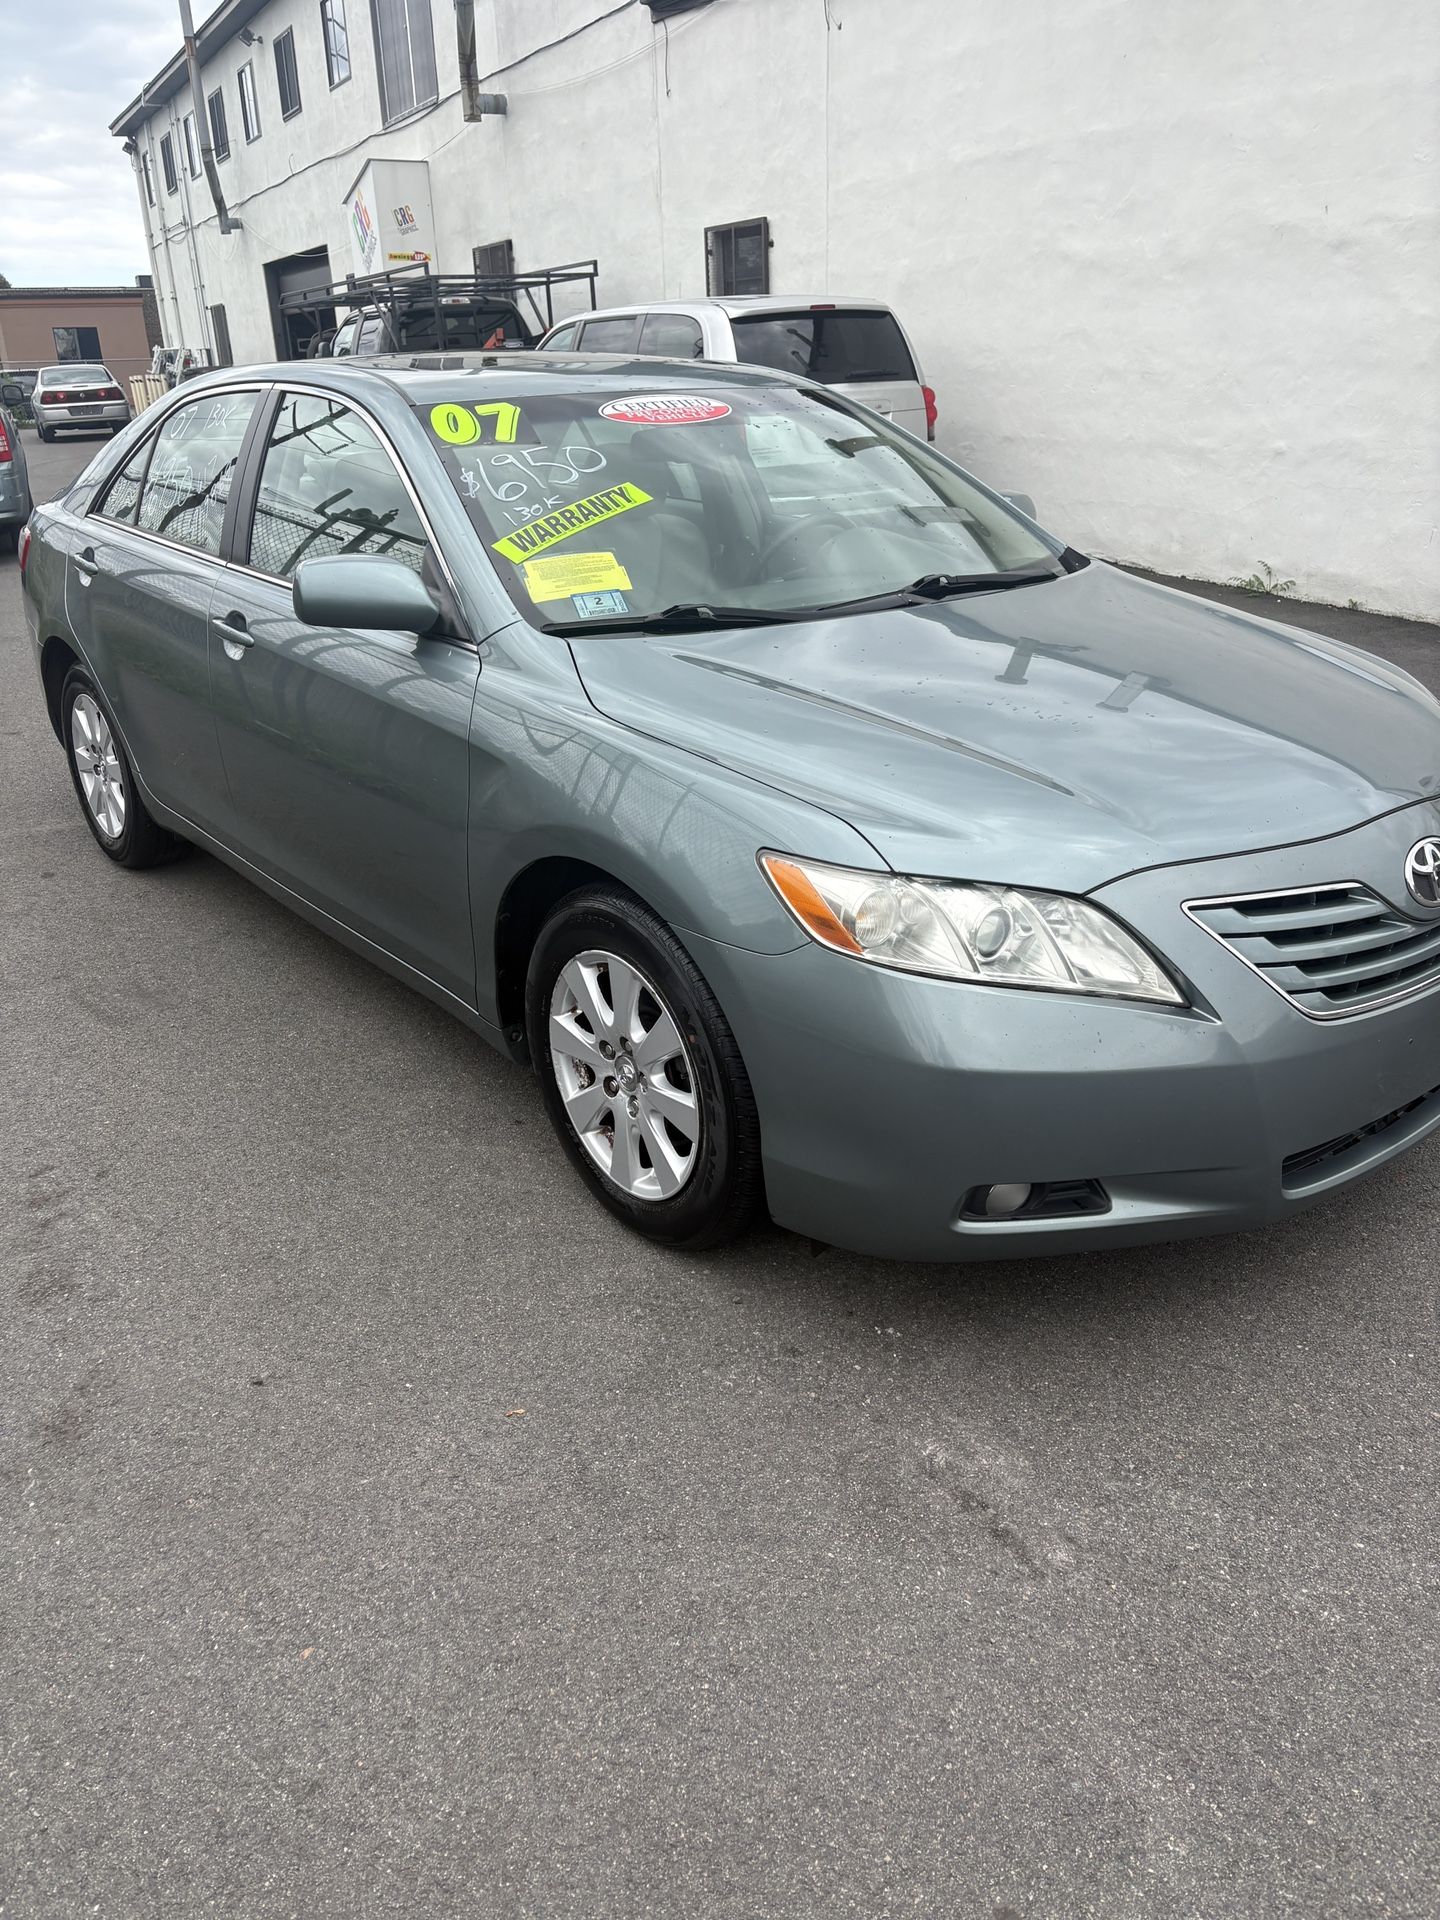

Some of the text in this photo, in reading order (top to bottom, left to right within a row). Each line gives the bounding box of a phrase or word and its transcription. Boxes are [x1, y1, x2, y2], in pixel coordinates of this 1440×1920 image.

[393, 205, 415, 227] CRG
[170, 405, 199, 439] 07
[611, 399, 712, 413] CERTIFIED
[645, 411, 711, 421] VEHICLE
[430, 402, 521, 445] 07
[460, 446, 607, 501] $6950
[502, 494, 564, 526] 130K
[506, 485, 637, 554] WARRANTY
[594, 597, 604, 606] 2
